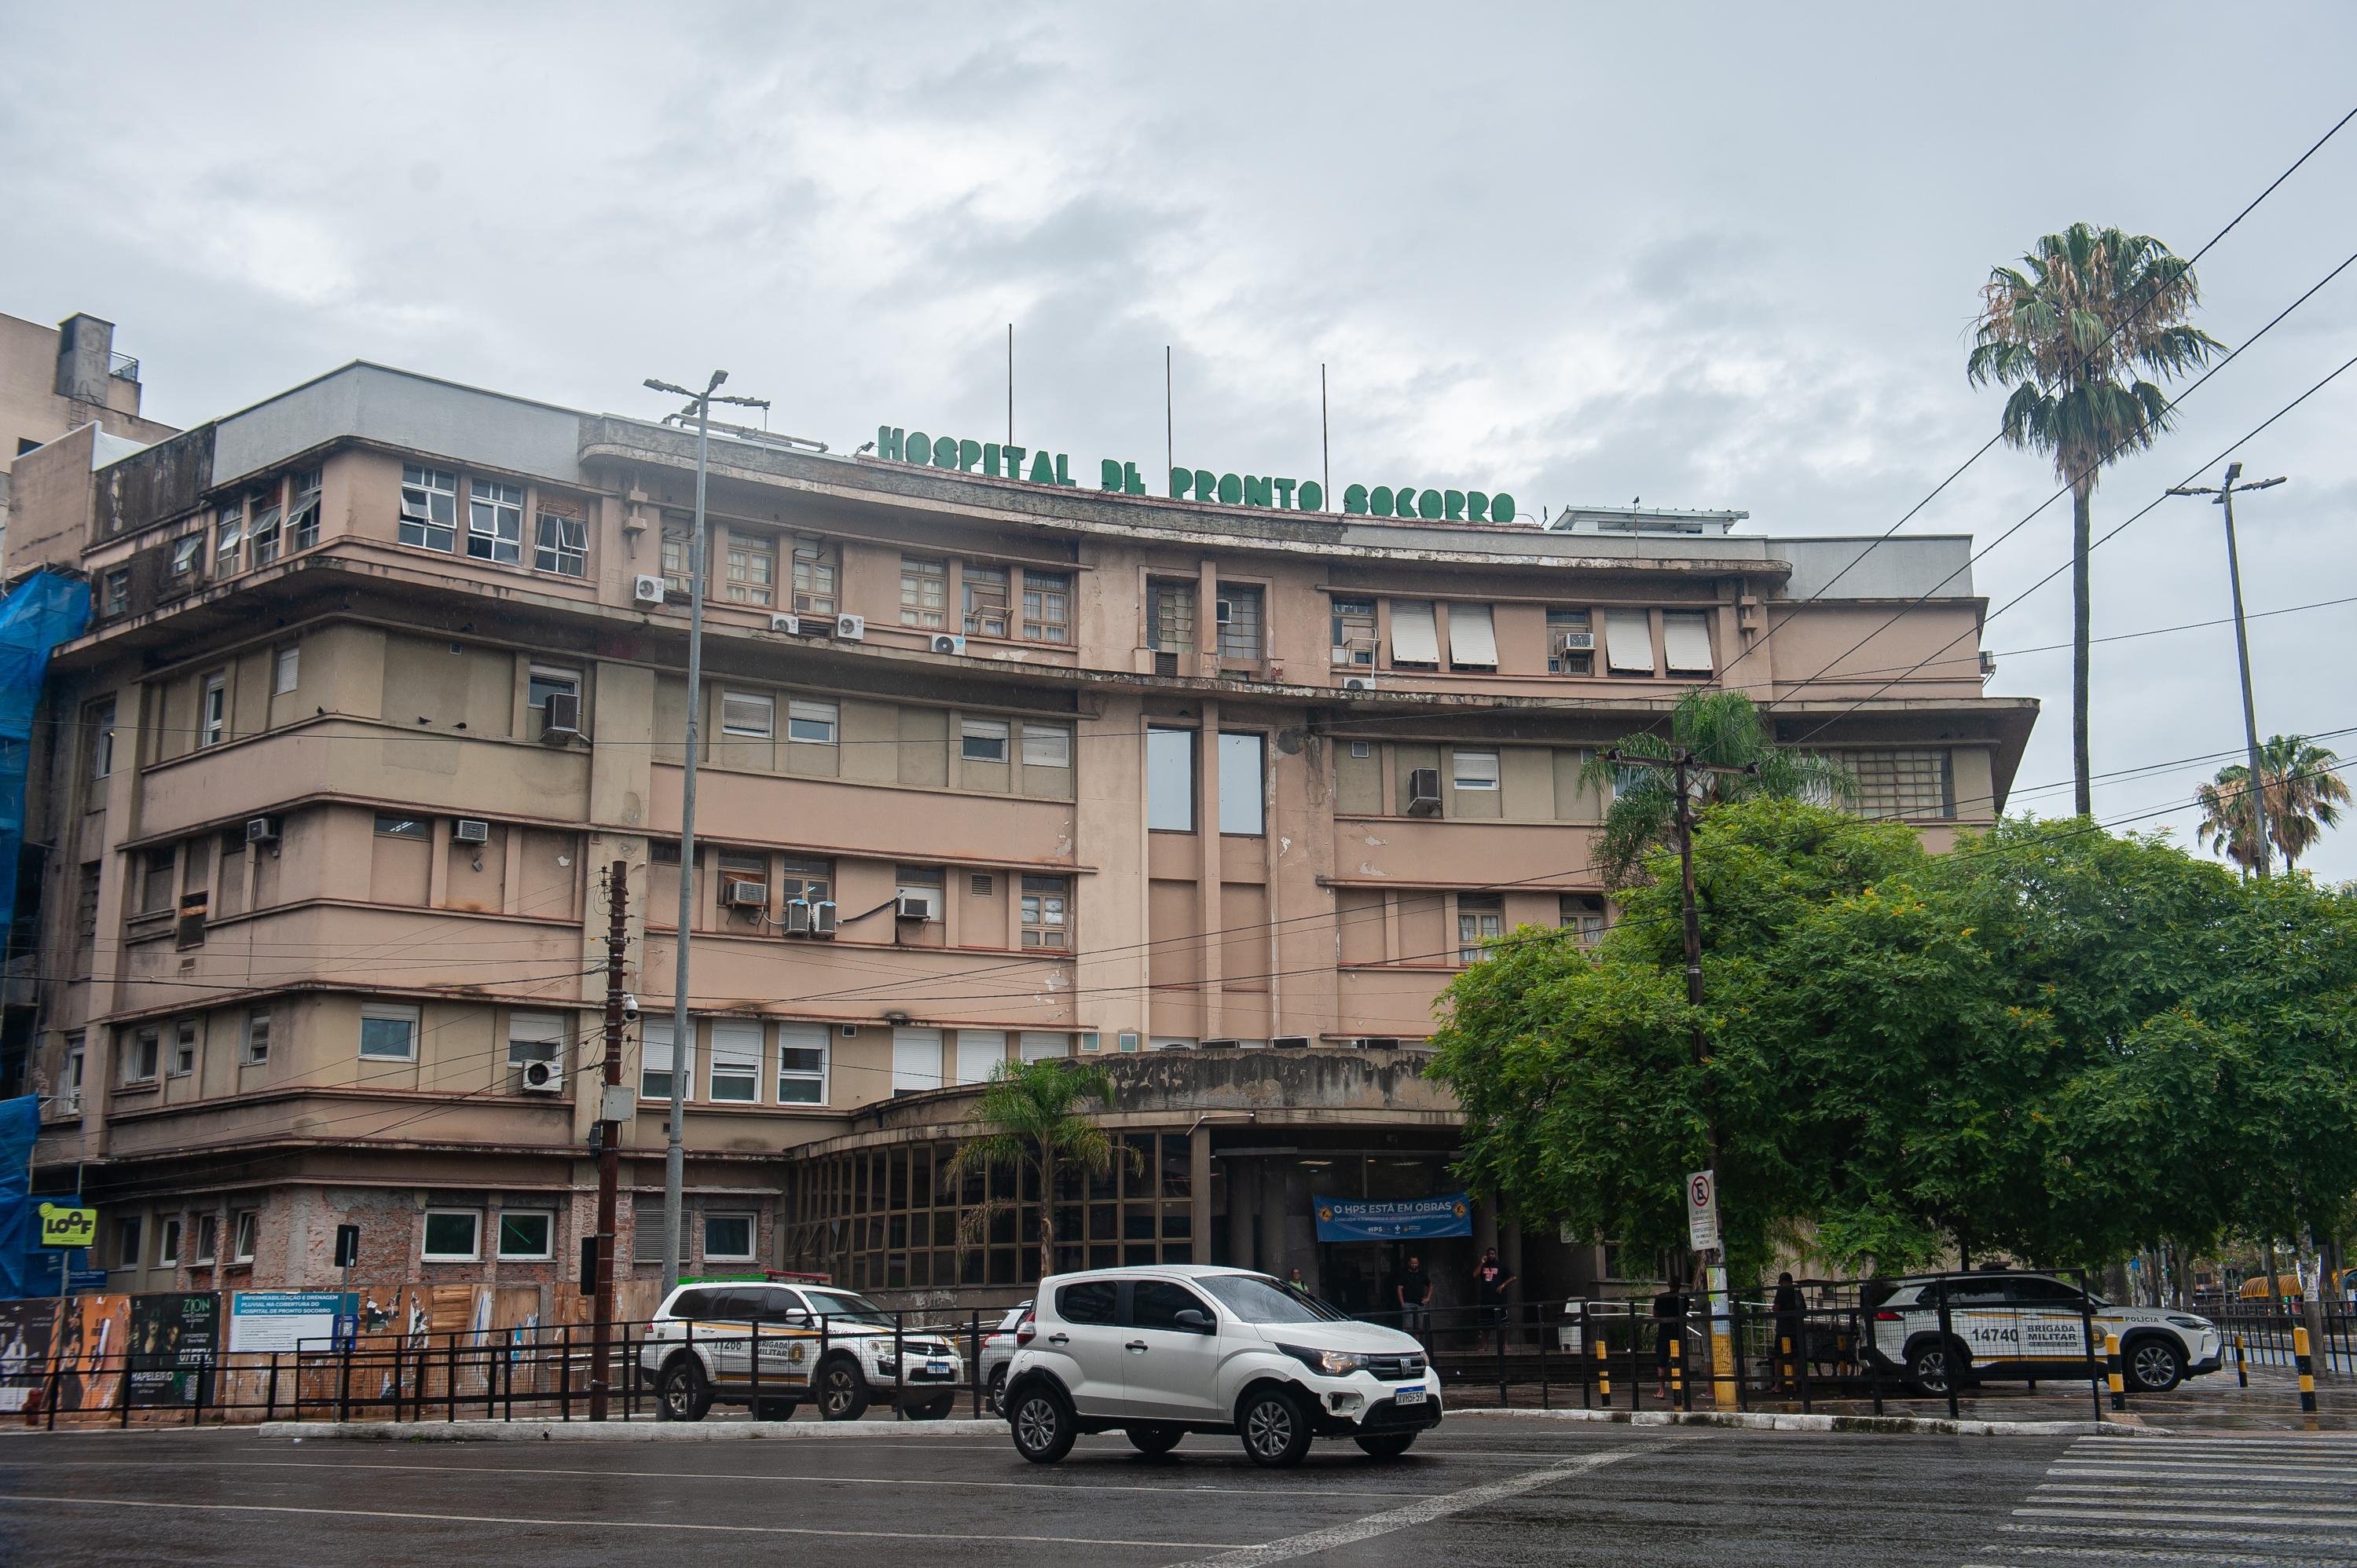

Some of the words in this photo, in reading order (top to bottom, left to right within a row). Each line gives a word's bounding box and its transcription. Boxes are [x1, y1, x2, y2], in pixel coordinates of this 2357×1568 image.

[878, 425, 1076, 487] HOSPITAL
[1102, 459, 1146, 495] DE
[1171, 467, 1322, 511] PRONTO
[1344, 483, 1516, 523] SOCORRO
[1334, 1205, 1342, 1214] O
[1345, 1204, 1366, 1214] HPS
[1369, 1203, 1395, 1213] ESTÁ
[1398, 1203, 1412, 1213] EM
[1415, 1202, 1452, 1212] OBRAS
[46, 1211, 93, 1234] LOOF
[1972, 1328, 2019, 1342] 14740
[131, 1371, 174, 1382] HAPELEIRO
